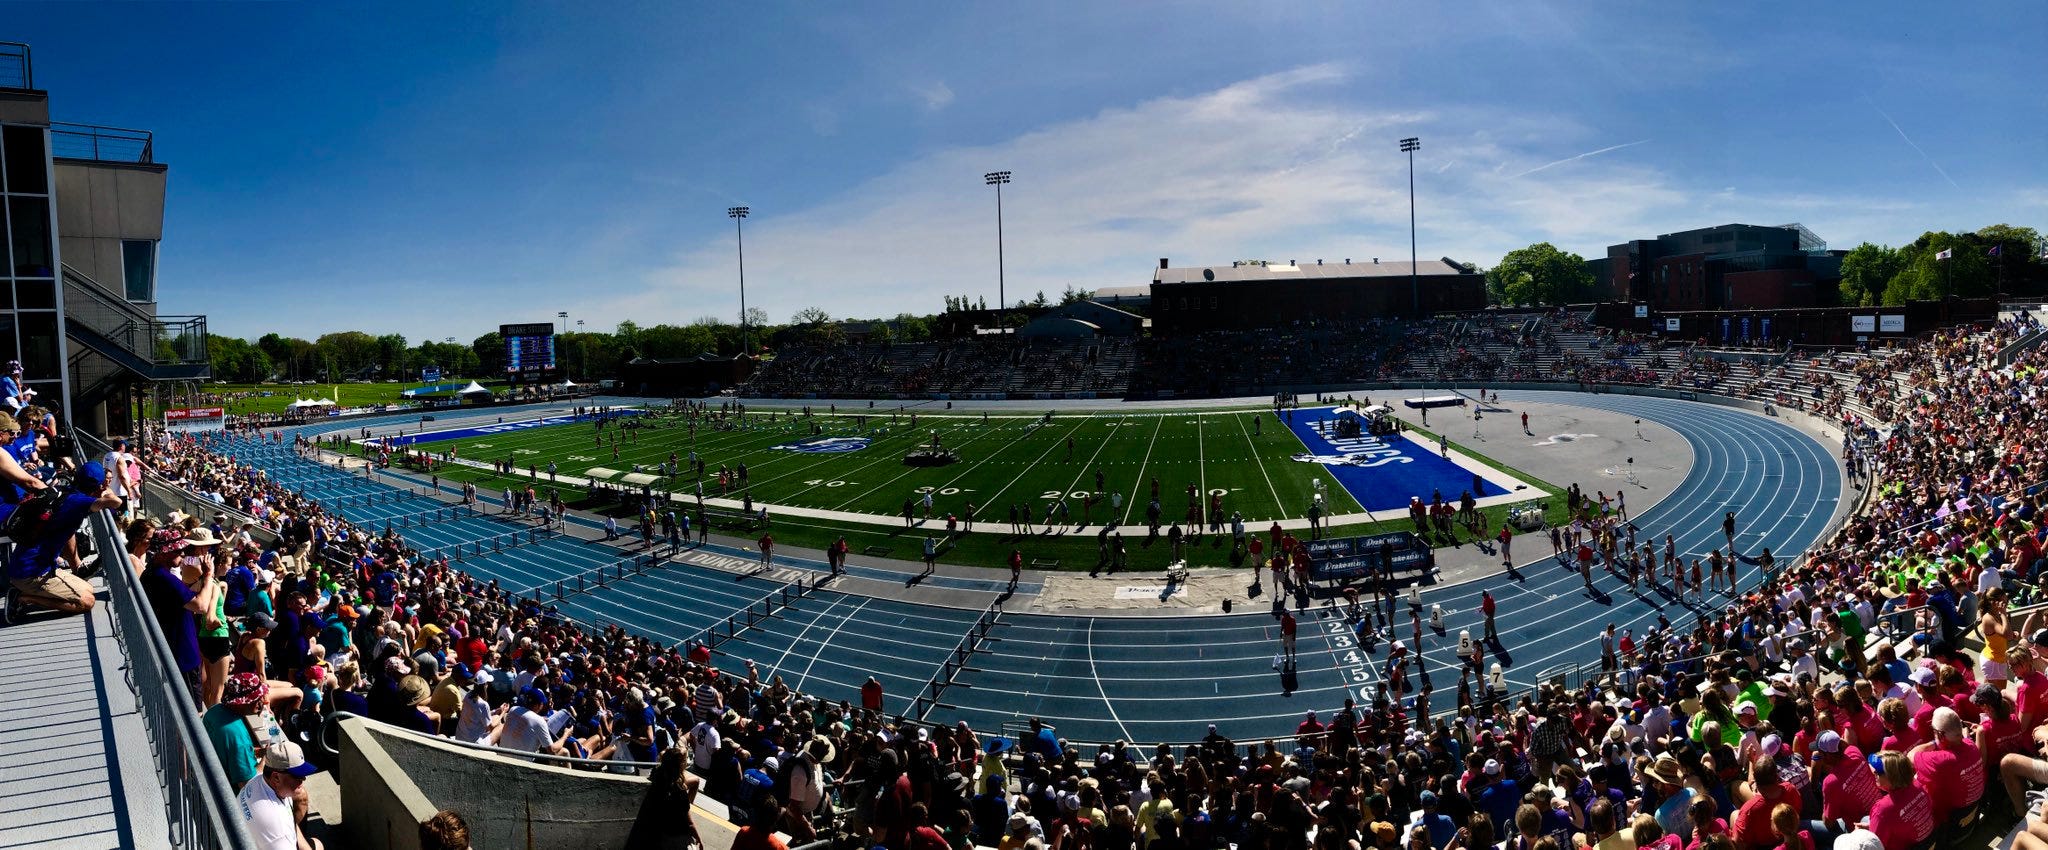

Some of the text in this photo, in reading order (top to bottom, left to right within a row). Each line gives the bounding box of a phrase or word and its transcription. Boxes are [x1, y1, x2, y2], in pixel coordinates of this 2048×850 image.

[803, 479, 846, 488] 40
[914, 486, 960, 495] 30
[1040, 490, 1090, 499] 20
[1411, 588, 1416, 597] 1
[1432, 611, 1438, 620] 3
[1328, 621, 1345, 633] 2
[1334, 635, 1352, 648] 3
[1462, 638, 1469, 648] 5
[1343, 650, 1363, 663] 4
[1351, 662, 1370, 682] 5
[1493, 672, 1500, 683] 7
[1360, 685, 1378, 701] 6
